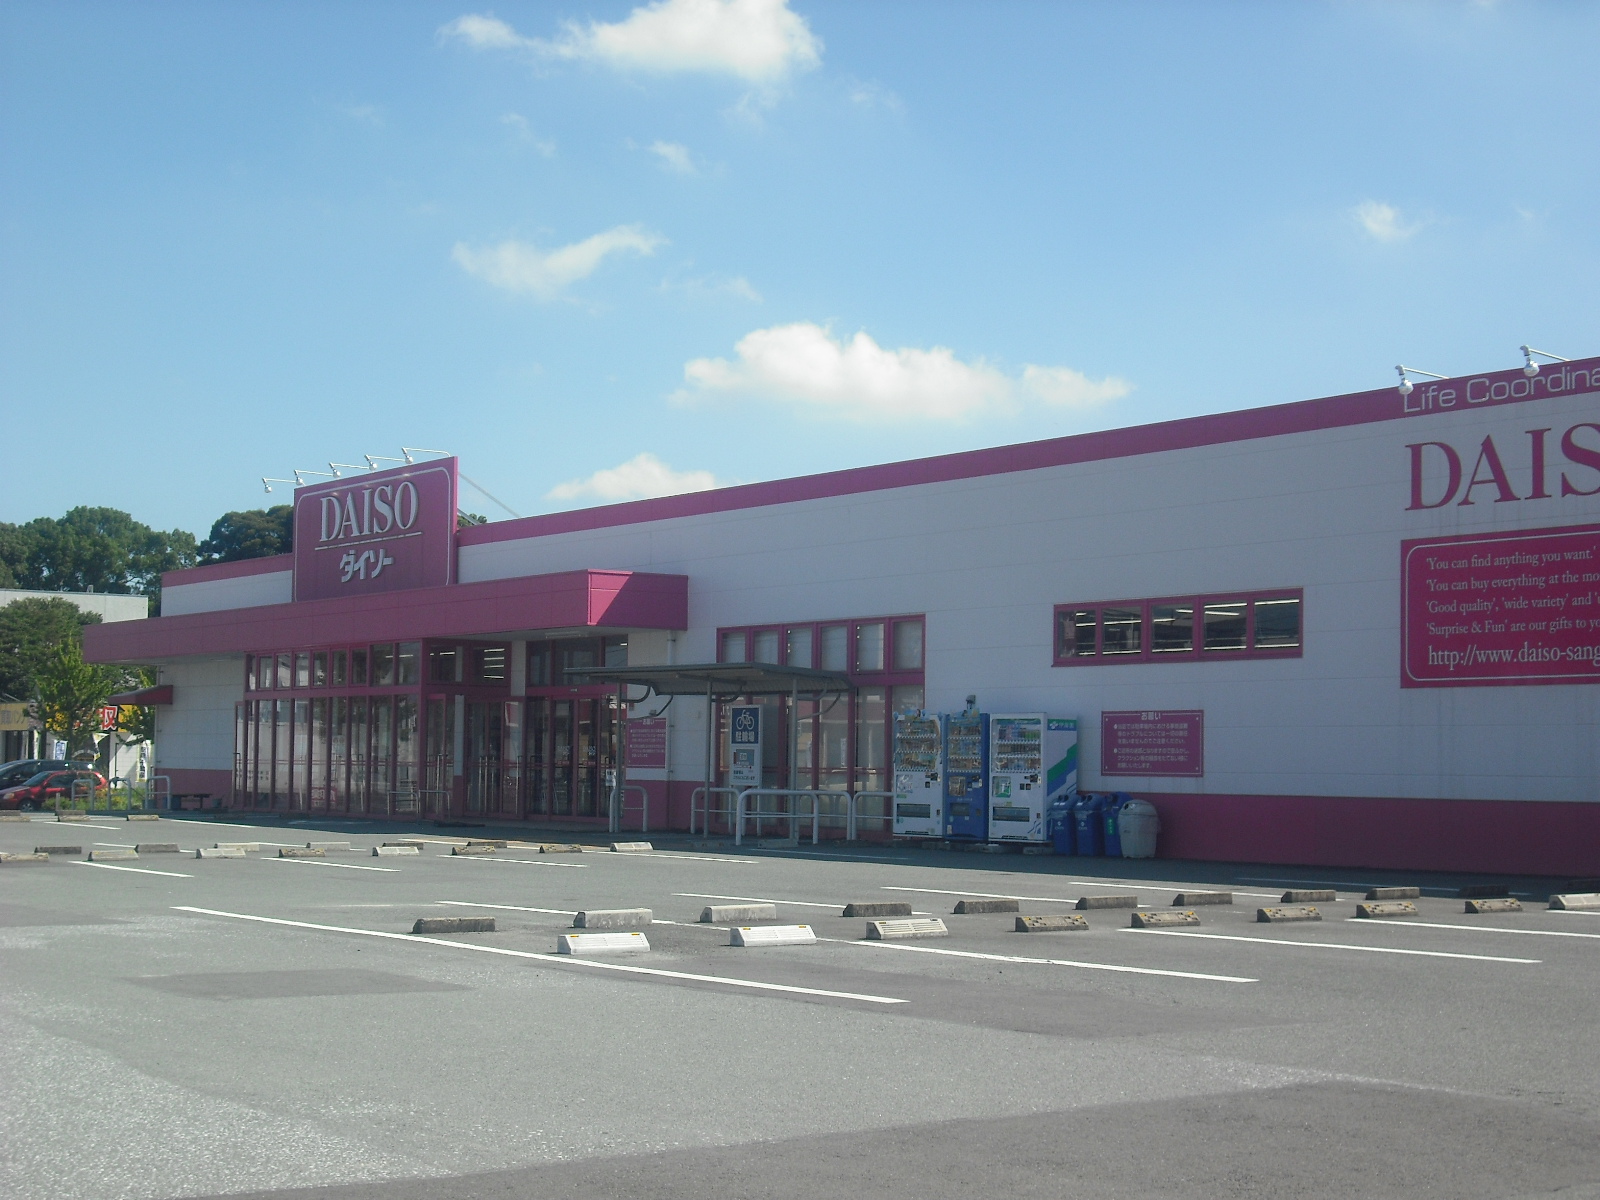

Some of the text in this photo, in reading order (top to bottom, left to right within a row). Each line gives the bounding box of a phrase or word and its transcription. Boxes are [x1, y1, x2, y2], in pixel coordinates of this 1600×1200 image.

[1404, 366, 1600, 413] Life Coordina
[1404, 422, 1600, 511] DAIS
[319, 481, 419, 542] DAISO
[339, 548, 394, 583] ダイソー
[1451, 559, 1468, 569] can
[1471, 553, 1491, 567] find
[1494, 552, 1539, 569] anything
[1542, 553, 1561, 566] you
[1451, 581, 1468, 590] can
[1471, 577, 1489, 592] buy
[1492, 573, 1546, 591] everything
[1549, 574, 1559, 584] at
[1562, 570, 1579, 583] the
[1571, 592, 1592, 606] and
[1471, 621, 1482, 633] &
[1510, 622, 1526, 632] are
[1528, 621, 1547, 631] our
[1549, 616, 1572, 634] gifts
[1575, 619, 1587, 629] to
[1428, 641, 1600, 671] http://www.daiso-sang
